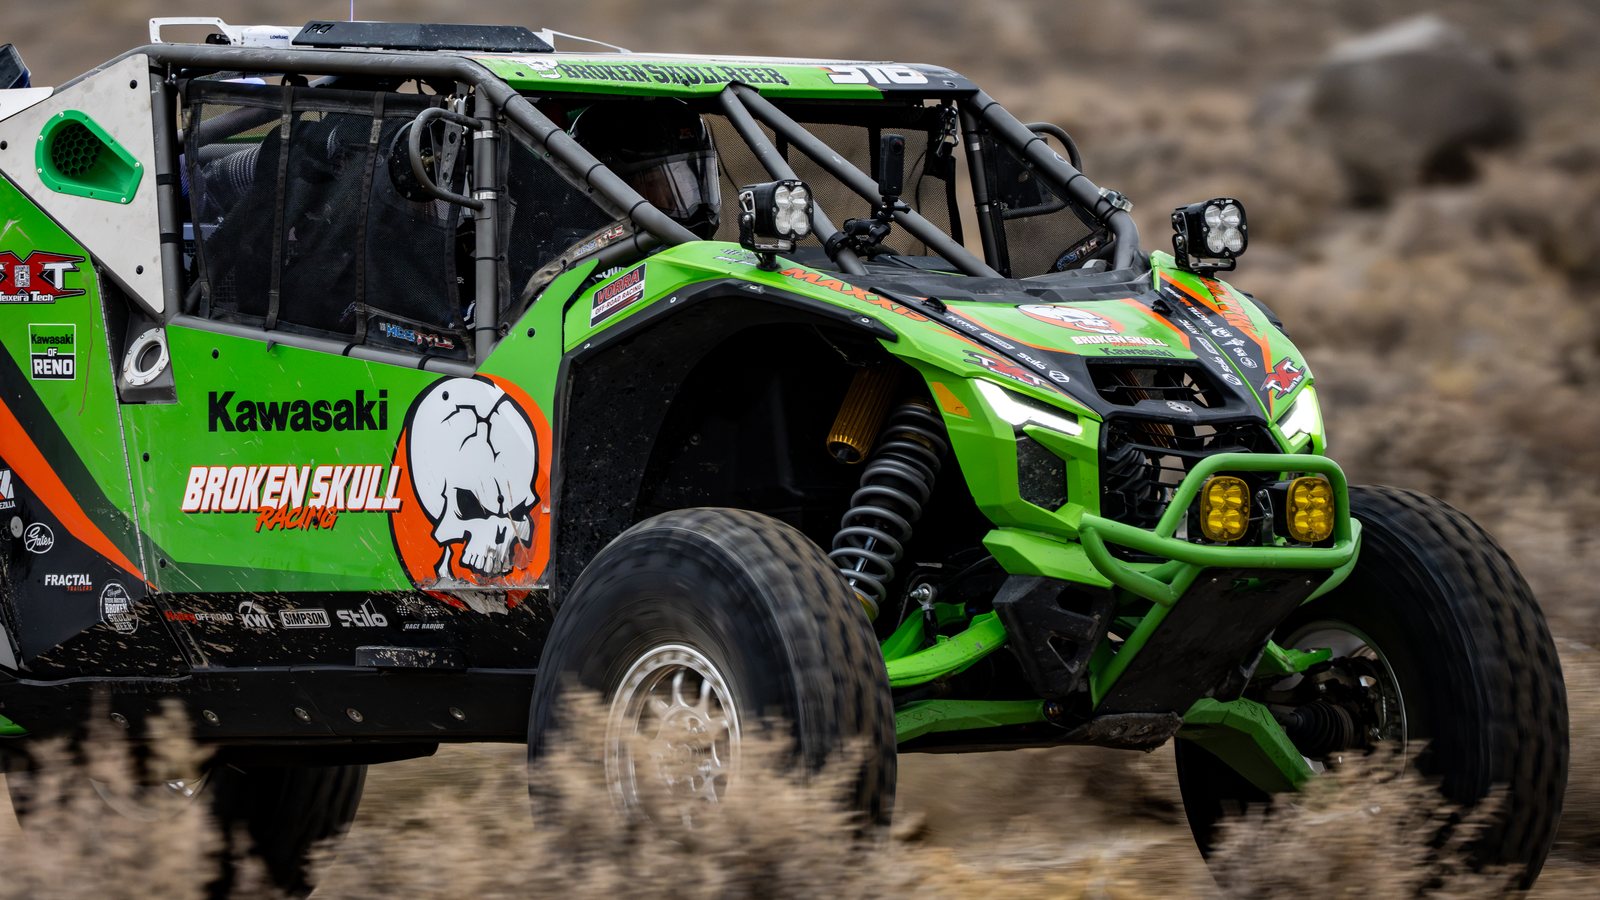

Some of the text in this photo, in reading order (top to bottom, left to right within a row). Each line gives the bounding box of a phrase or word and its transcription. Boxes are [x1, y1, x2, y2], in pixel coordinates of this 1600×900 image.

[304, 23, 335, 35] PCI
[597, 269, 641, 305] VORRA
[30, 291, 54, 301] Tech
[594, 283, 643, 315] OFF-ROAD RACING
[31, 334, 74, 345] Kawasaki
[1070, 336, 1126, 345] BROKEN
[1124, 336, 1170, 347] SKULL
[47, 348, 58, 357] OF
[1099, 347, 1176, 358] Kawasaki
[33, 359, 74, 375] RENO
[208, 390, 388, 432] Kawasaki
[181, 464, 403, 512] BROKEN SKULL
[254, 503, 339, 533] RACING
[44, 573, 93, 586] FRACTAL
[283, 611, 326, 626] SIMPSON
[336, 600, 388, 628] Stilo
